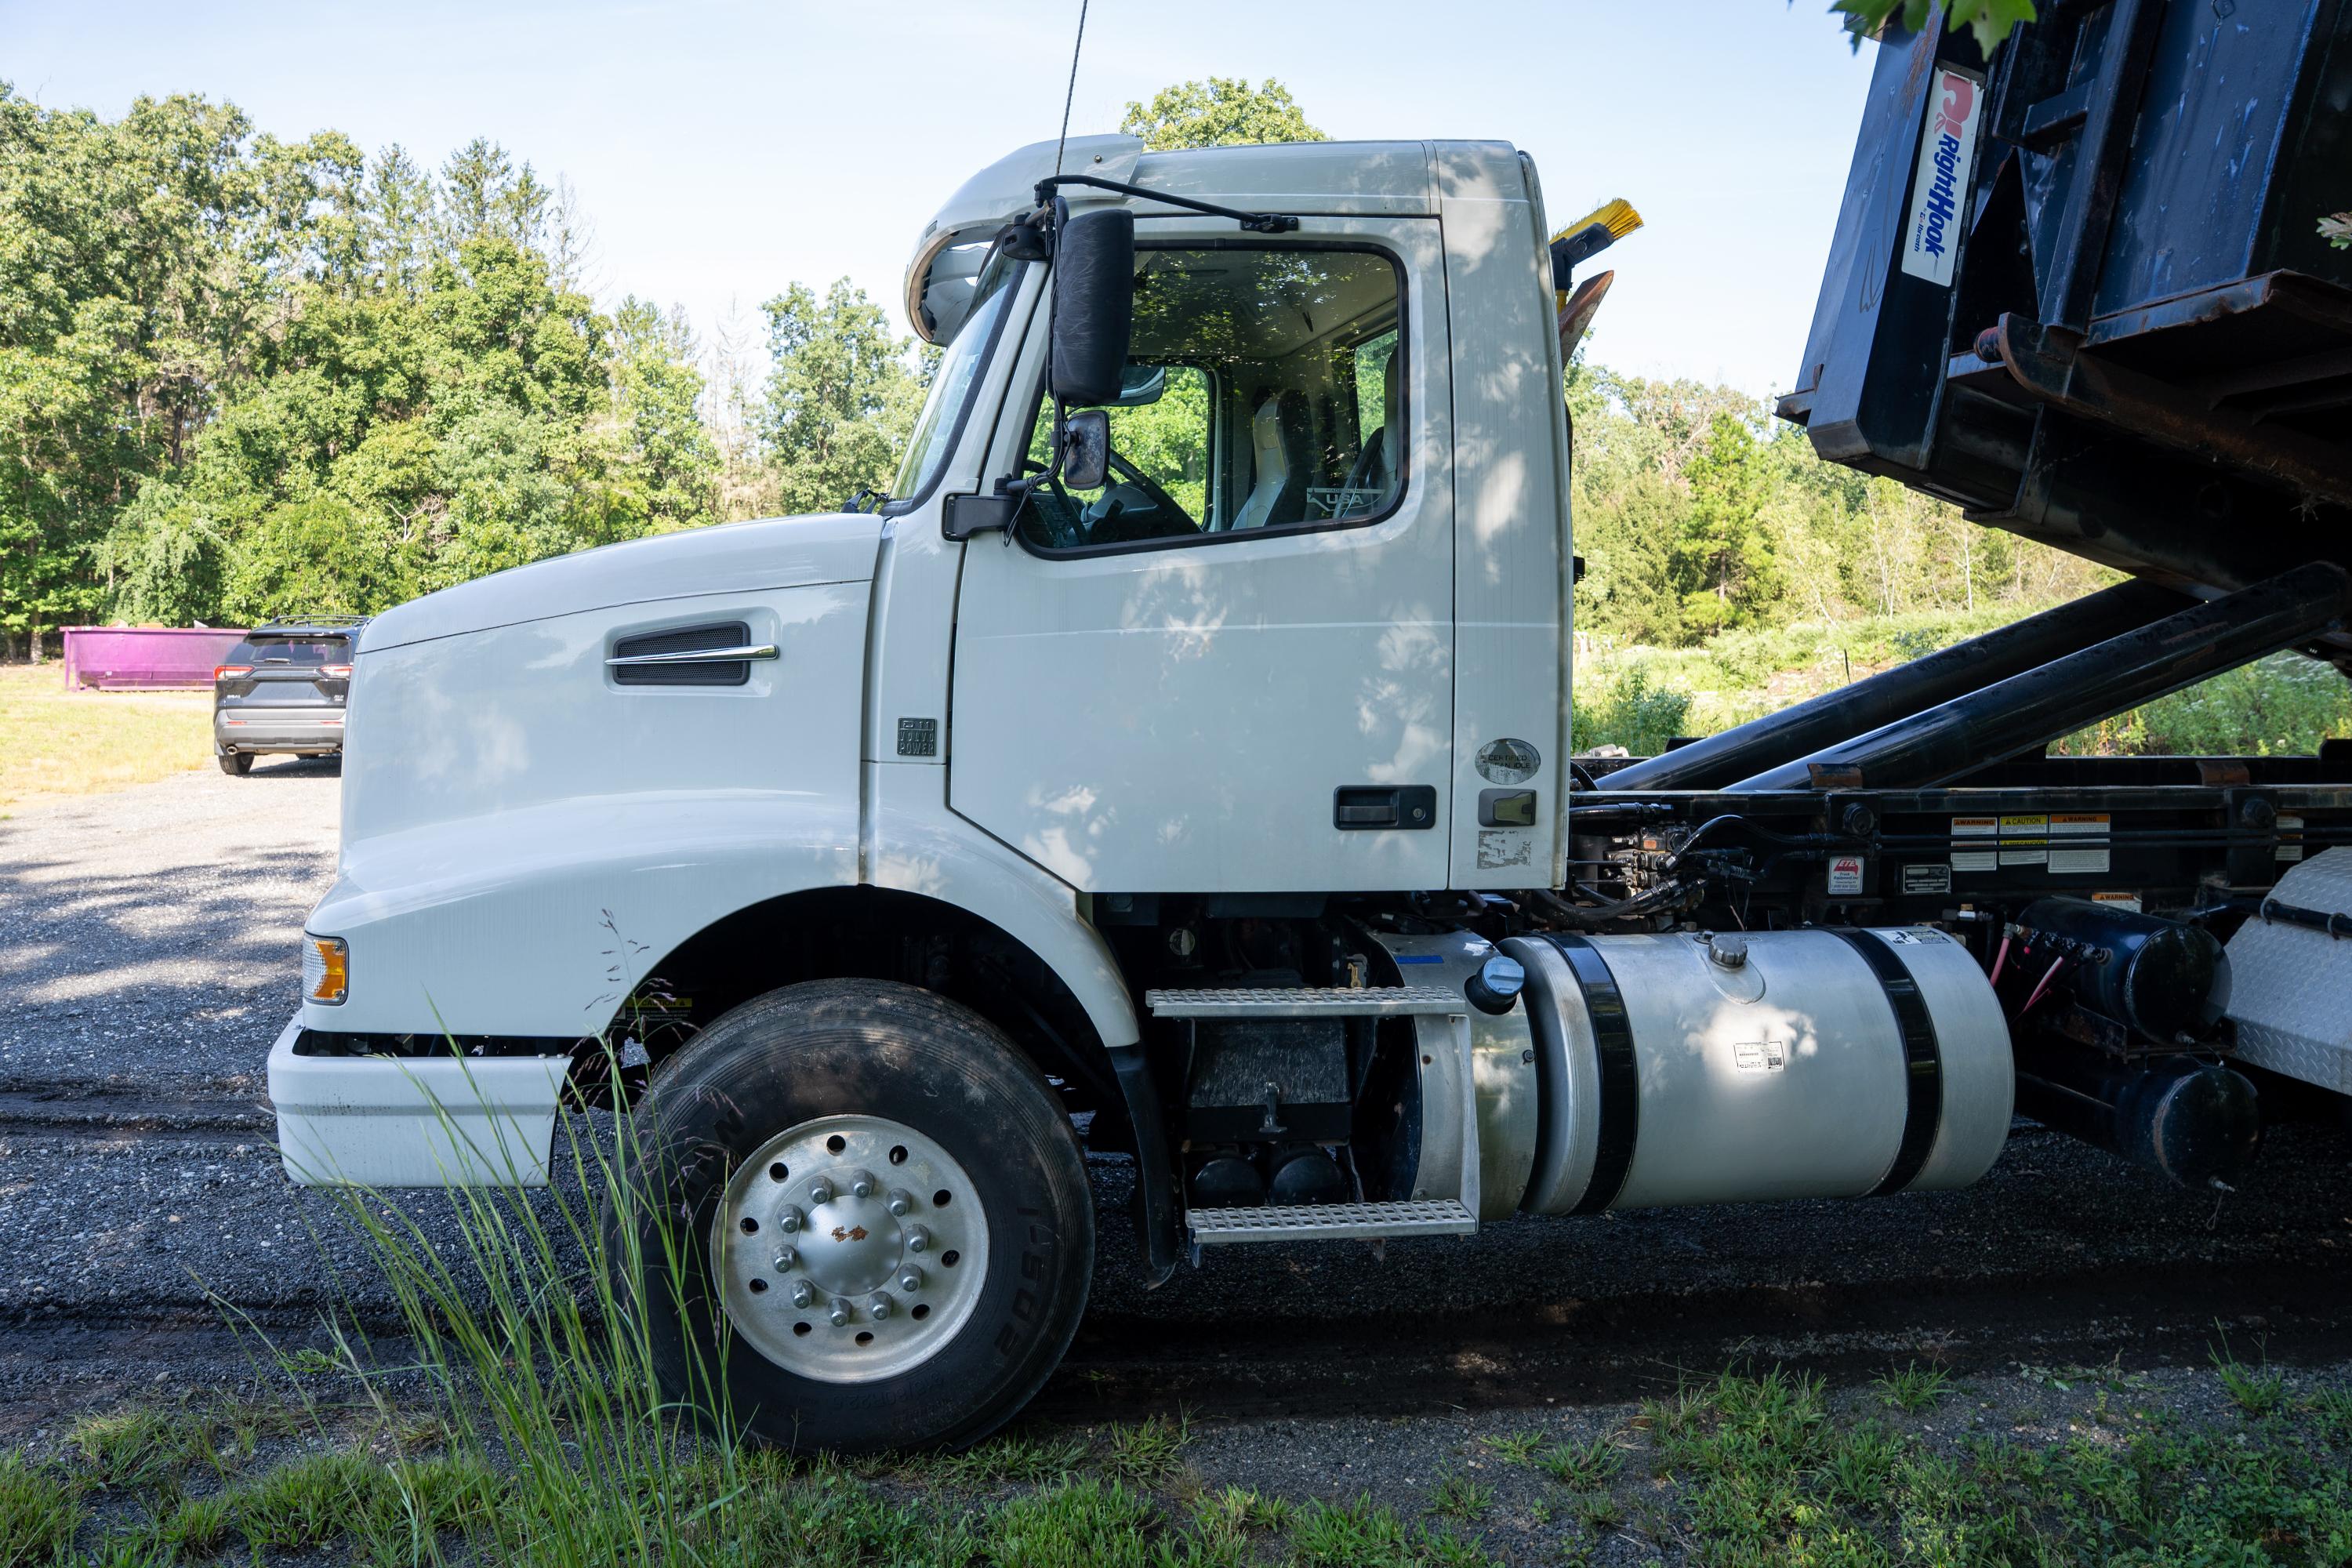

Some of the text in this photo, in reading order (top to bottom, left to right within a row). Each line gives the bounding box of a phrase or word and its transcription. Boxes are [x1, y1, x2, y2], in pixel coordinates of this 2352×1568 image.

[1925, 133, 1961, 259] RightHook
[1326, 494, 1364, 505] USA
[899, 731, 934, 742] VOLVO
[899, 742, 934, 754] POWER
